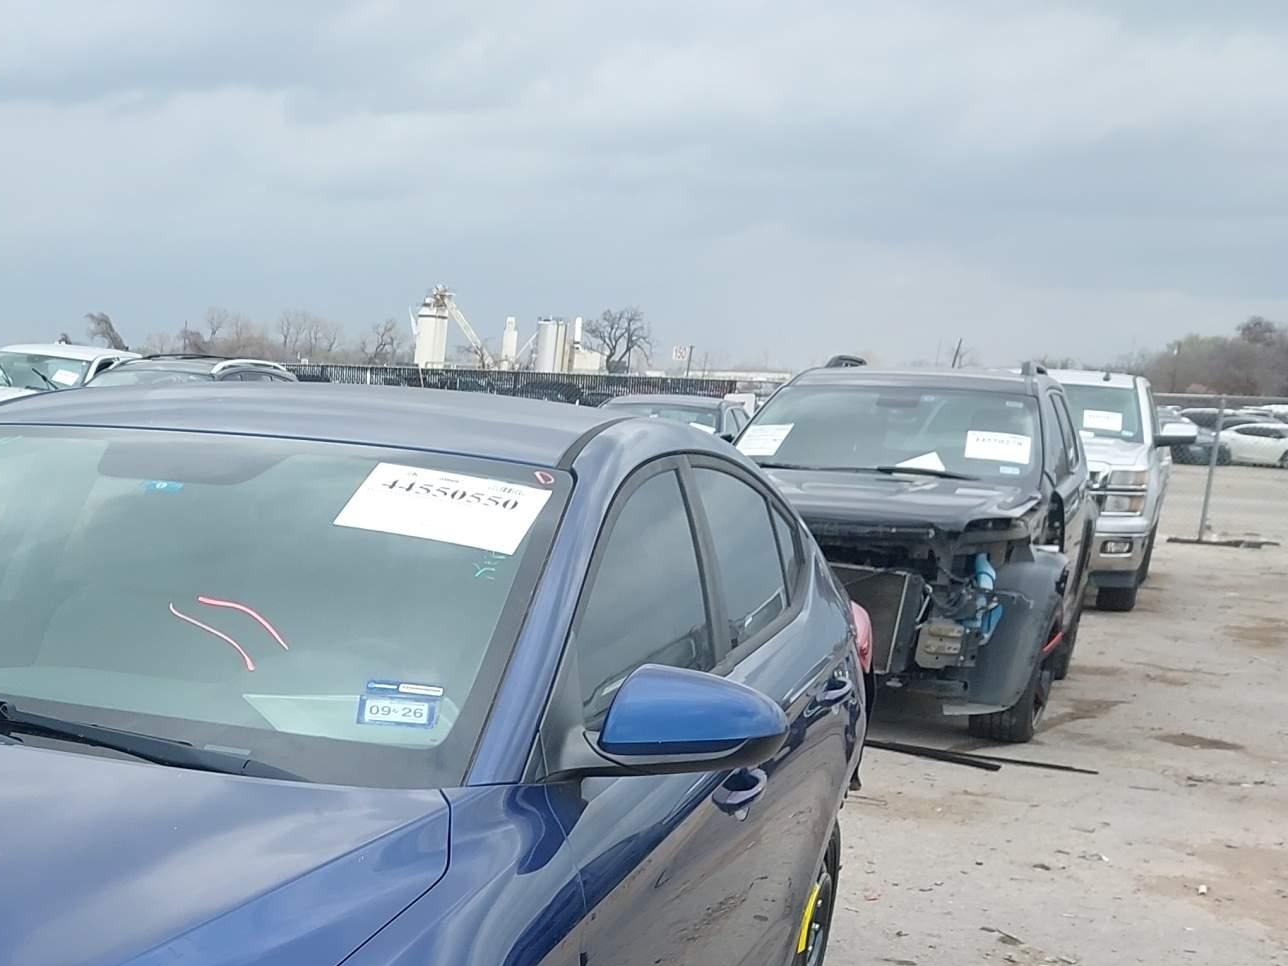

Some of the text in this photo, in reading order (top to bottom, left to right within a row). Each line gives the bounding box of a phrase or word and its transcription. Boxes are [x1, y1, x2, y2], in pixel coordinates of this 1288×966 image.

[381, 479, 519, 511] 44550550
[369, 704, 424, 719] 09 26
